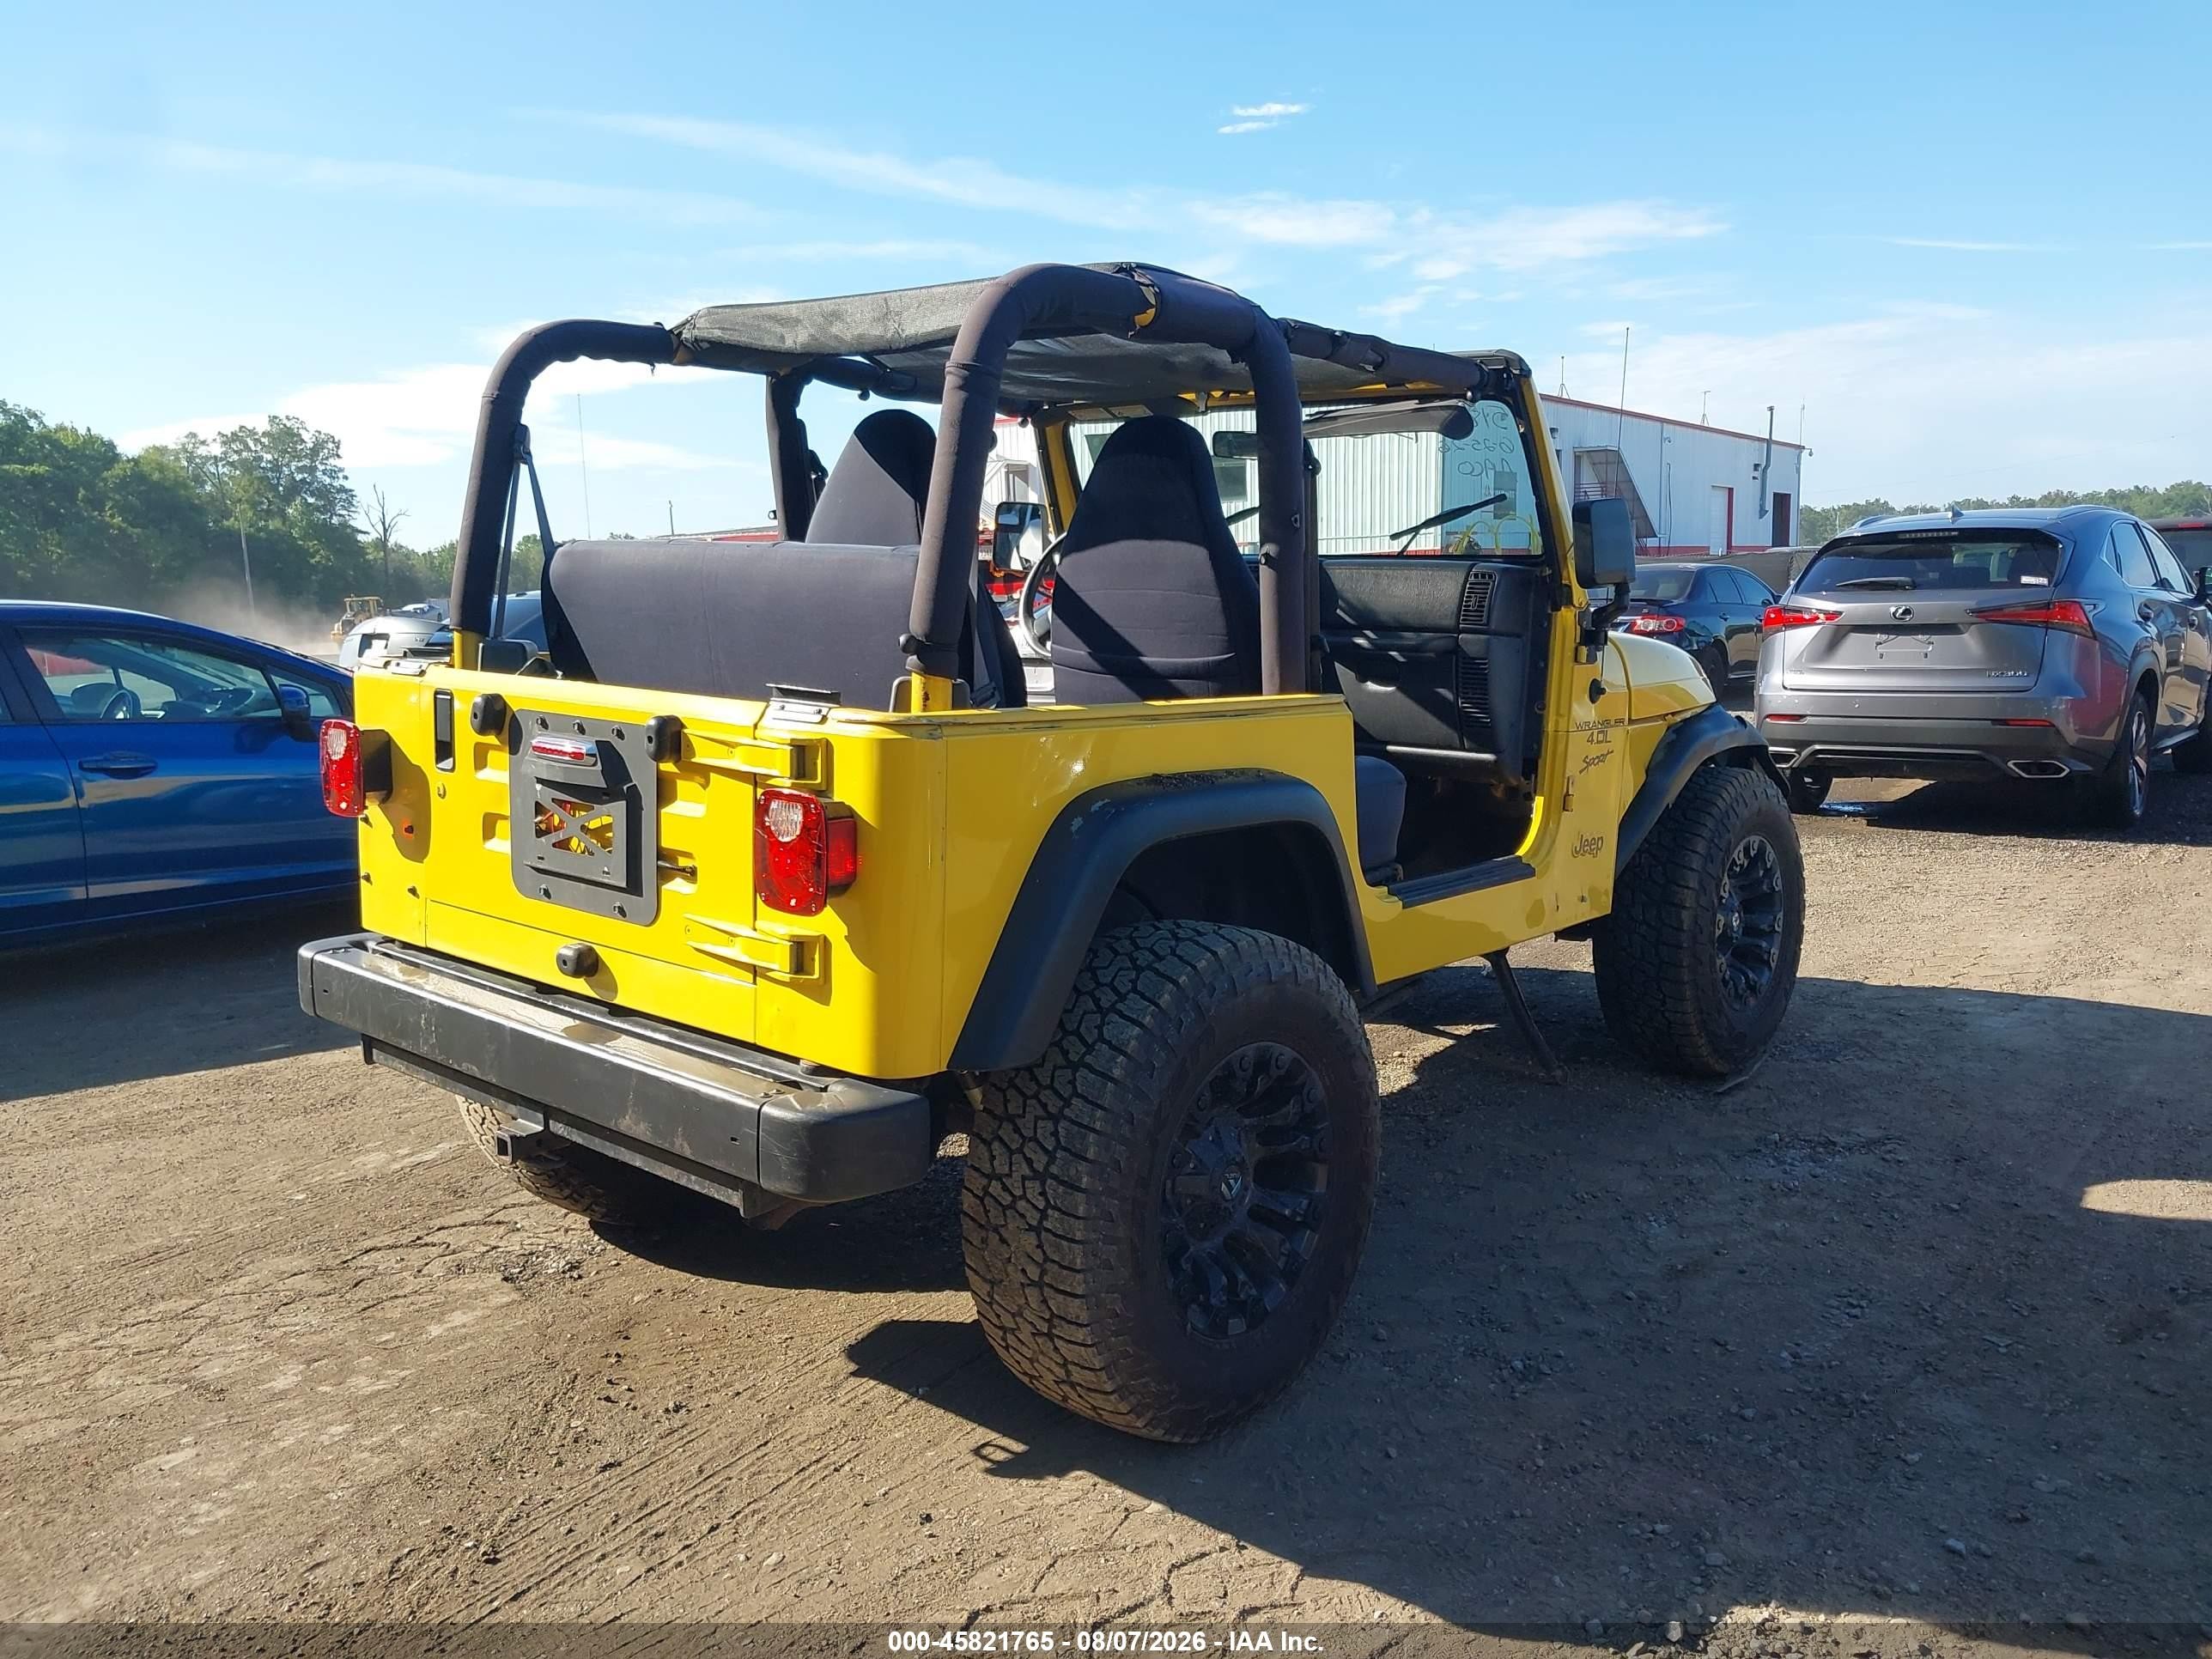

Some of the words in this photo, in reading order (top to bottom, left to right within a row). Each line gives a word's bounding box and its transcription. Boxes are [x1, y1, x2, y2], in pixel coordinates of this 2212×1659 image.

[1575, 718, 1626, 730] WRANGLER
[1586, 730, 1612, 745] 4.0L
[1572, 834, 1604, 859] Jeep
